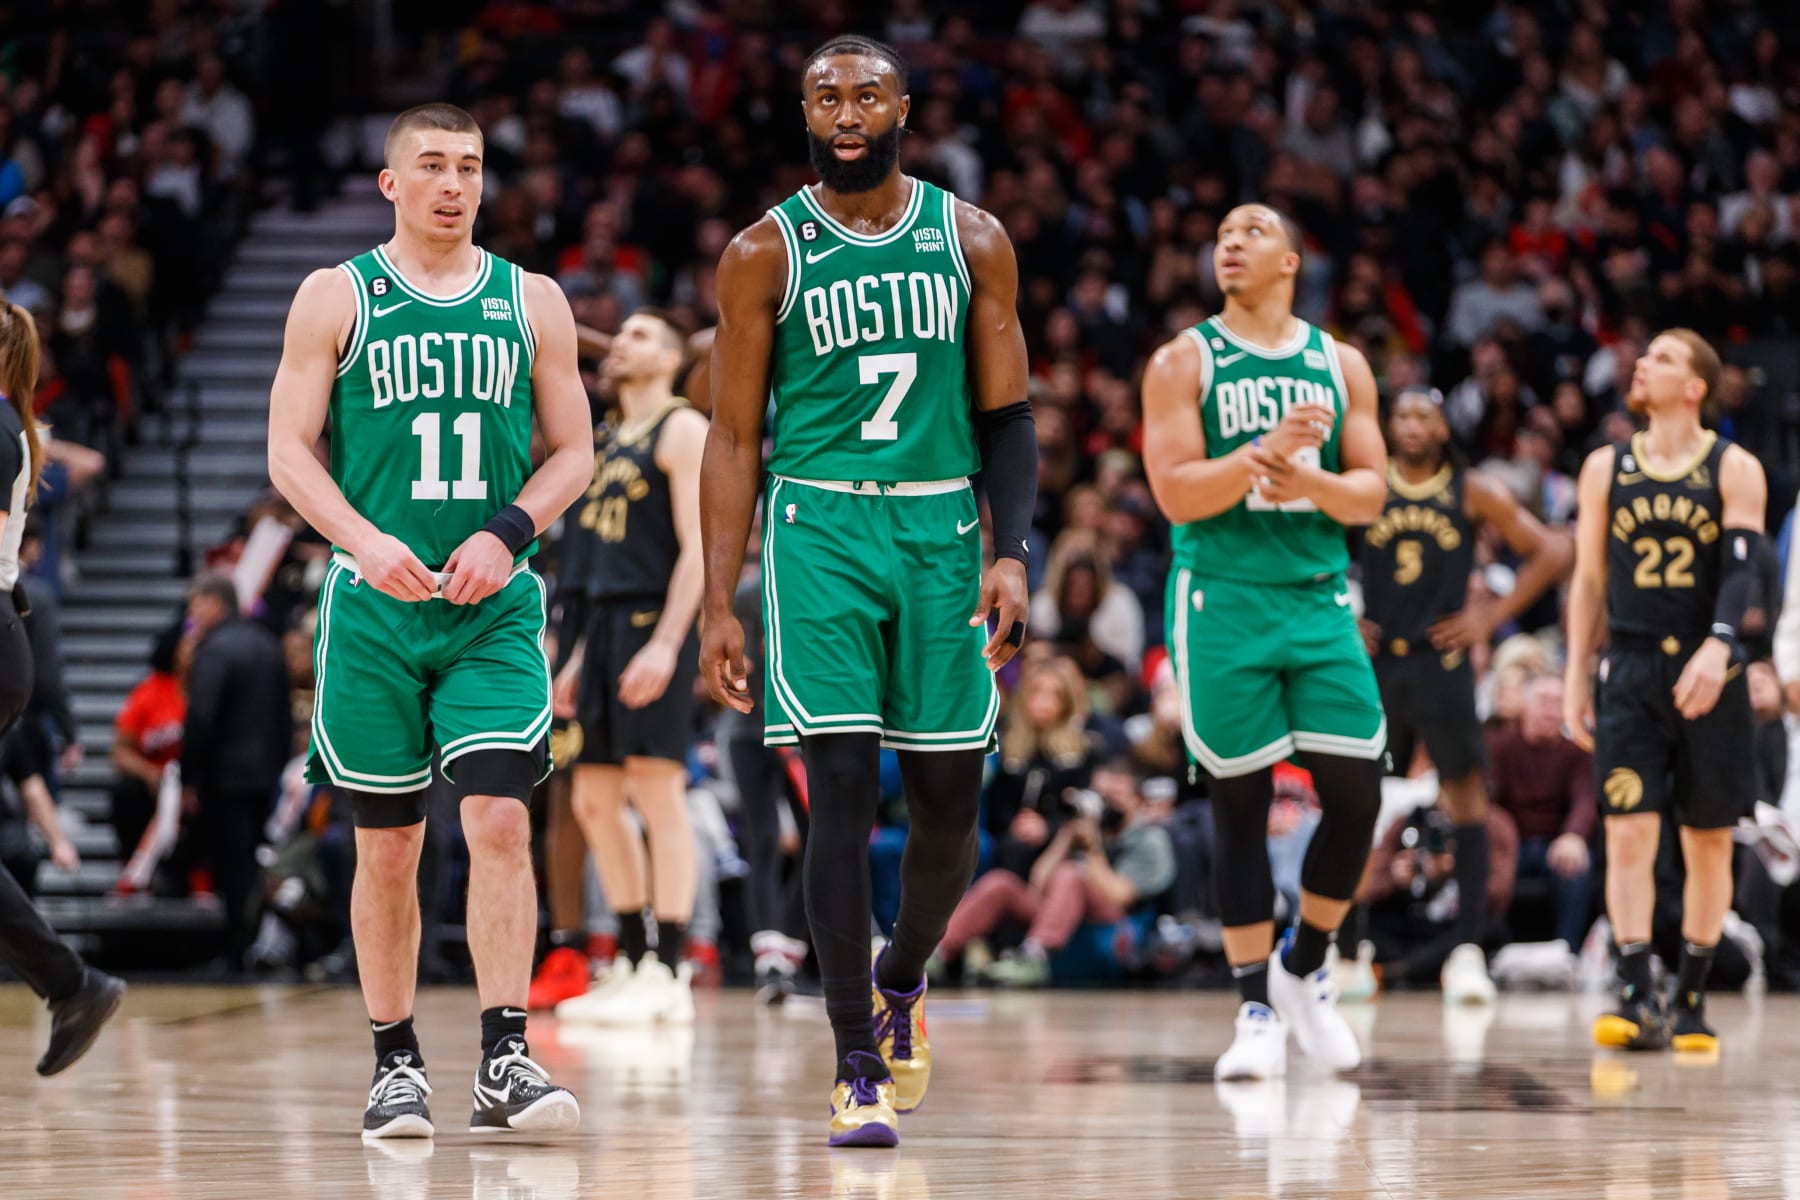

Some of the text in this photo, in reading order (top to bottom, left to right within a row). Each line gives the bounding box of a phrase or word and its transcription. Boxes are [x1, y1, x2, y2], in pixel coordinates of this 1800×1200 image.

[801, 222, 817, 240] 6
[912, 227, 944, 242] VISTA
[915, 241, 945, 253] PRINT
[372, 278, 387, 296] 6
[481, 298, 511, 312] VISTA
[483, 310, 513, 321] PRINT
[803, 272, 958, 357] BOSTON
[367, 332, 520, 409] BOSTON
[858, 352, 917, 441] 7
[411, 412, 488, 500] 11
[1394, 540, 1423, 585] 5
[1632, 536, 1696, 589] 22
